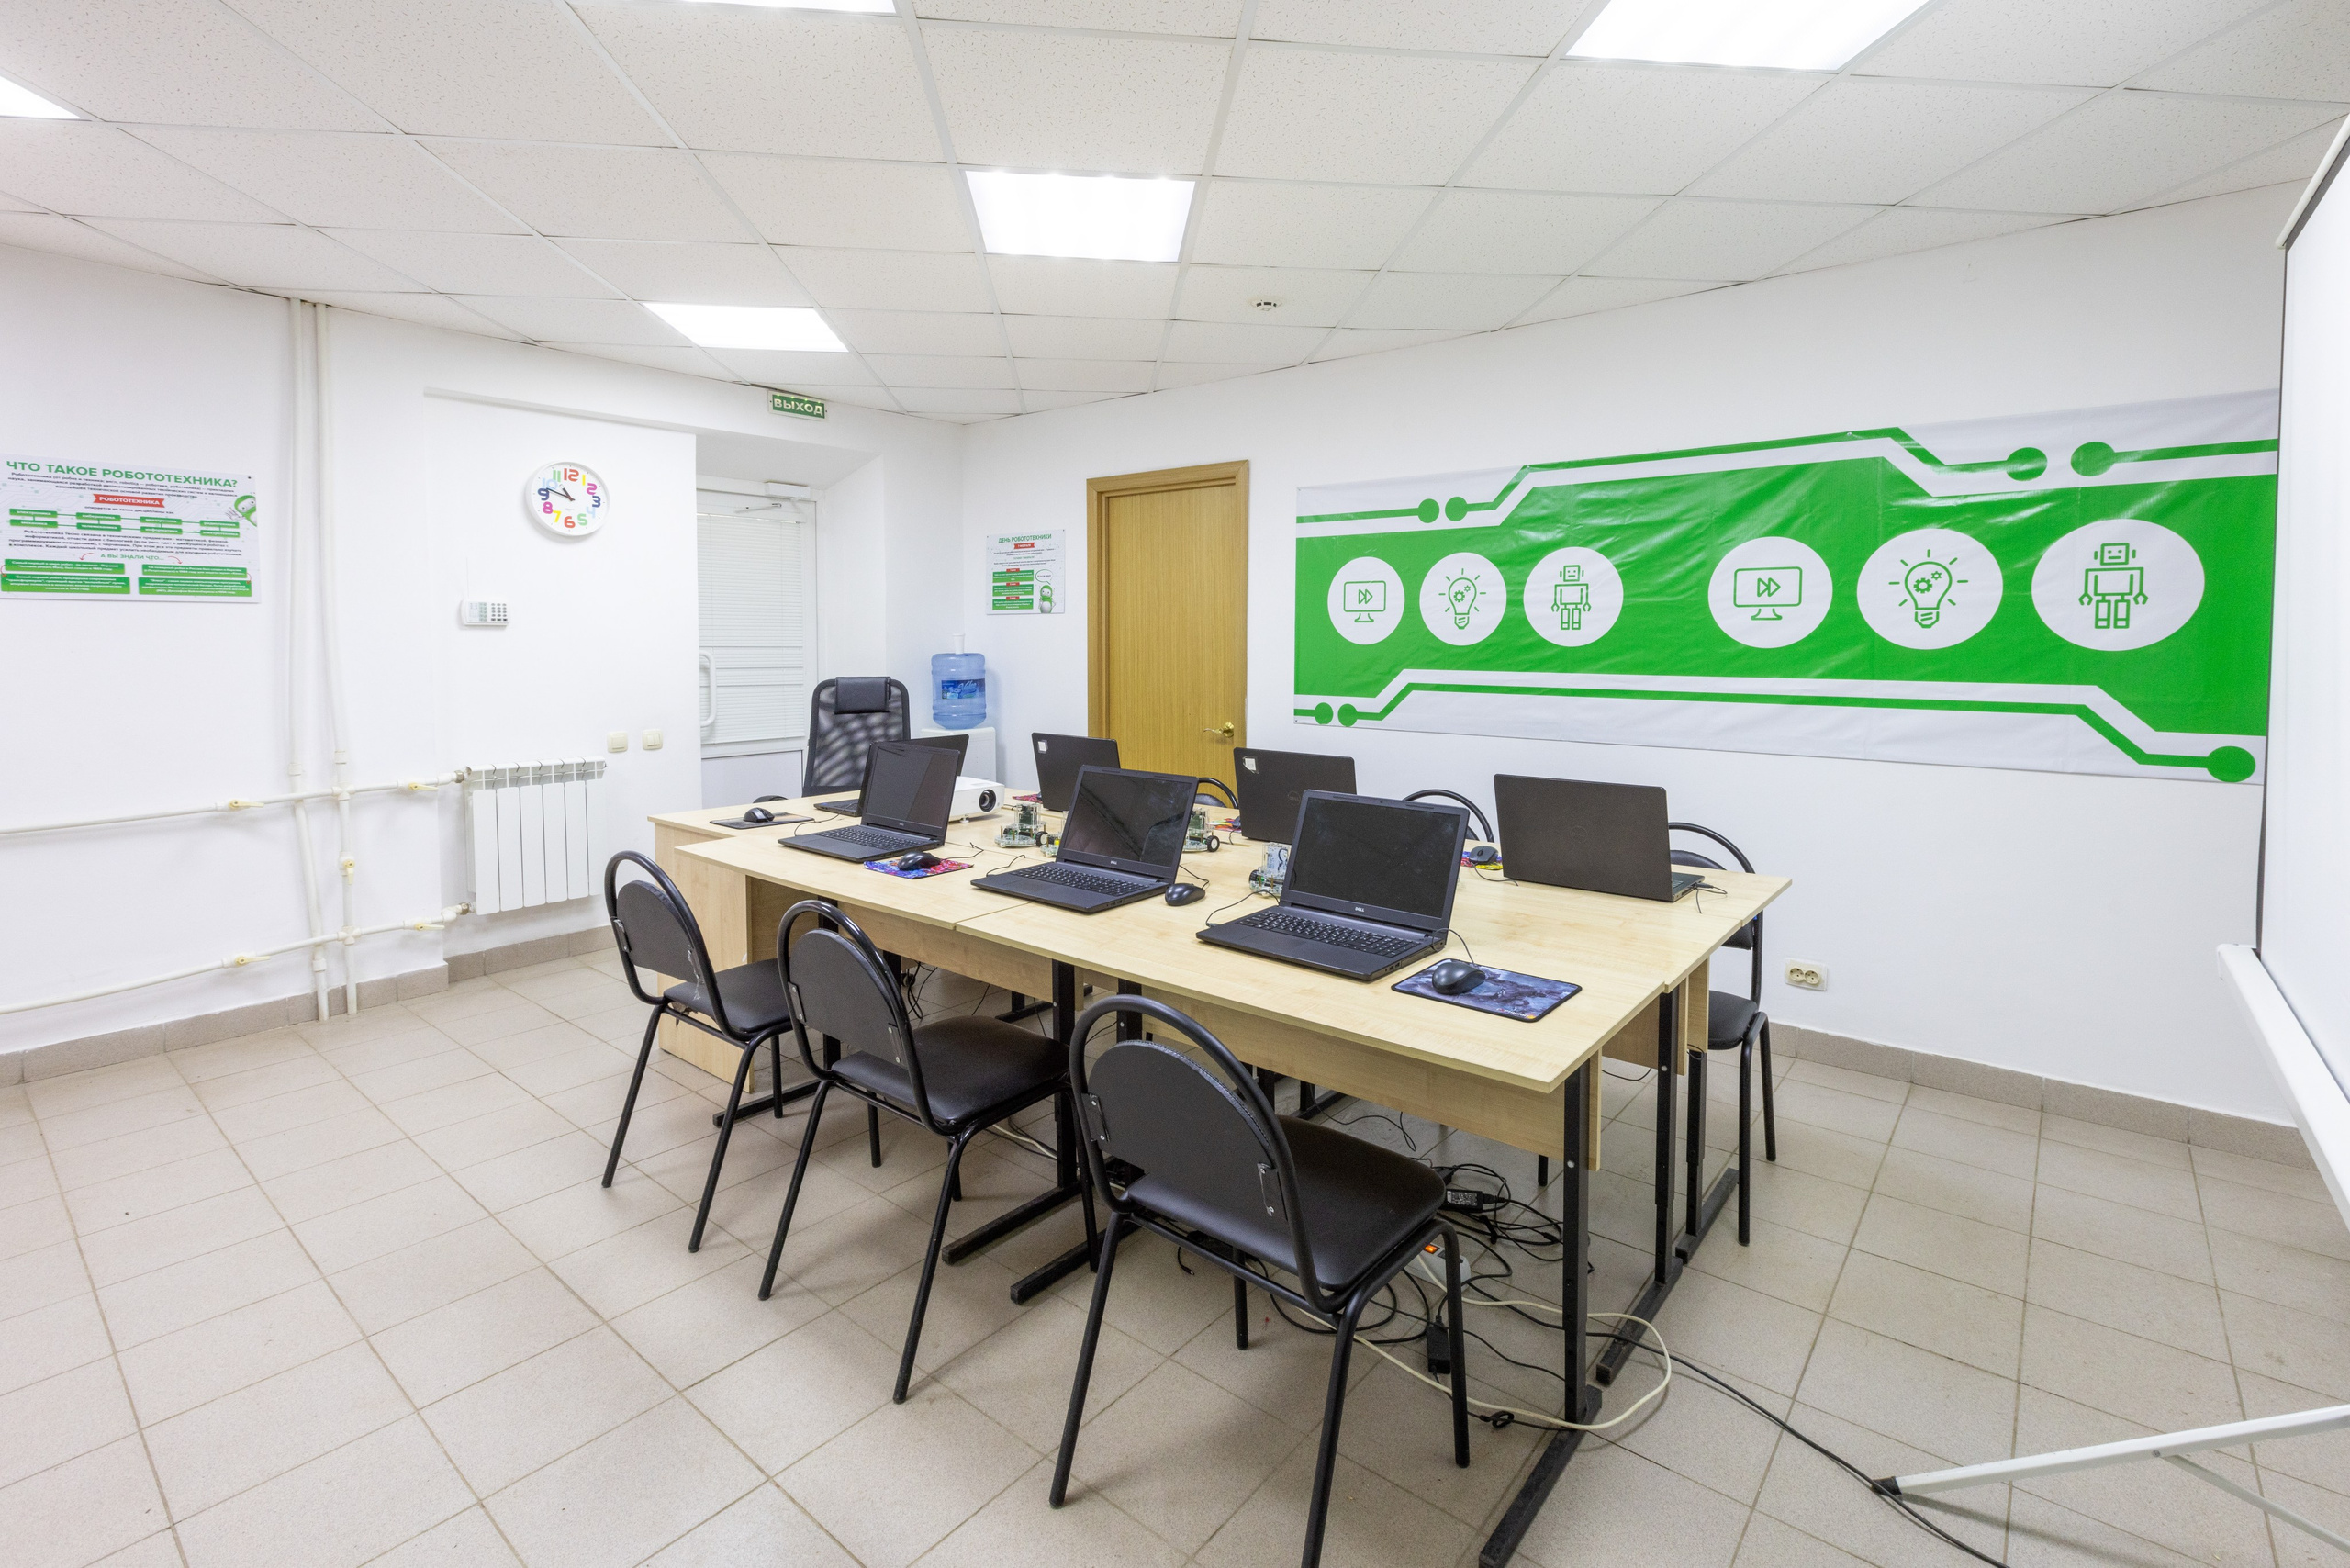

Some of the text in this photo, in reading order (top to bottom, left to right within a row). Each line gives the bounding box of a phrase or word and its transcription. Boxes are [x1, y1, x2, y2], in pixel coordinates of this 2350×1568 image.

[773, 398, 823, 416] ВЫХОД
[6, 461, 237, 487] ЧТО ТАКОЕ РОБОТОТЕХНИКА?
[553, 469, 562, 483] 11
[564, 468, 579, 482] 12
[582, 474, 586, 487] 1
[542, 477, 558, 490] 10
[586, 483, 598, 496] 2
[98, 496, 160, 505] РОБОТОТЕХНИКА
[537, 488, 550, 501] 9
[542, 501, 553, 514] 8
[591, 496, 601, 508] 3
[553, 510, 562, 523] 7
[586, 506, 595, 519] 4
[564, 516, 576, 529] 6
[576, 513, 588, 526] 5
